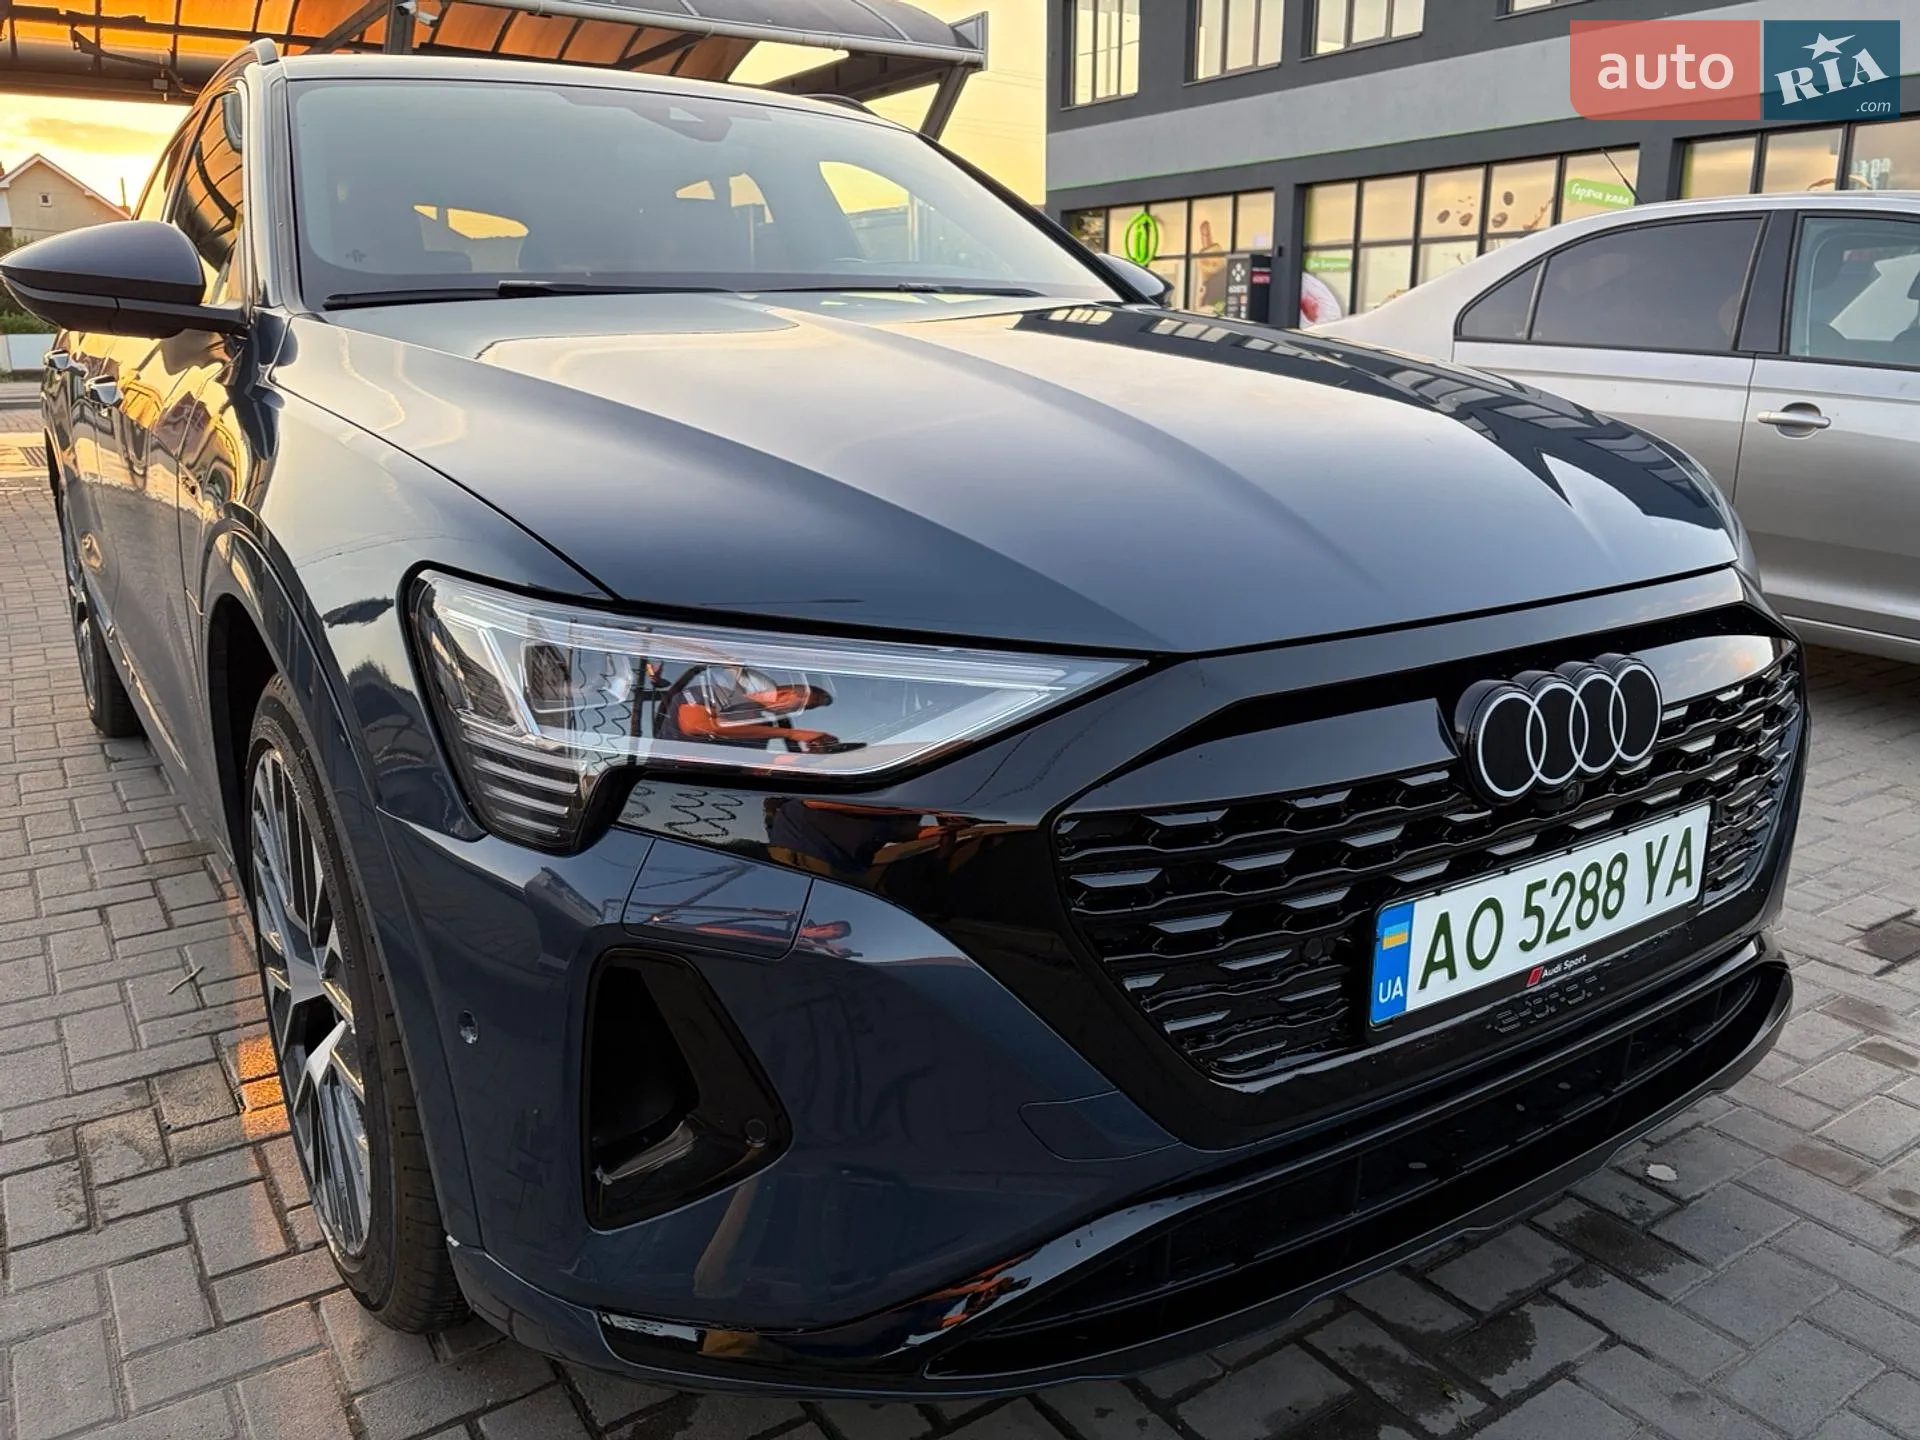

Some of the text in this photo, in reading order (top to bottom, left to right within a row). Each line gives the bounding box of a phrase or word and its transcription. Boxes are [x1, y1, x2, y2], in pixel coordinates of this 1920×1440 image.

[1417, 826, 1693, 991] AO 5288 YA
[1541, 954, 1588, 978] Audi Sport
[1378, 977, 1405, 1004] UA
